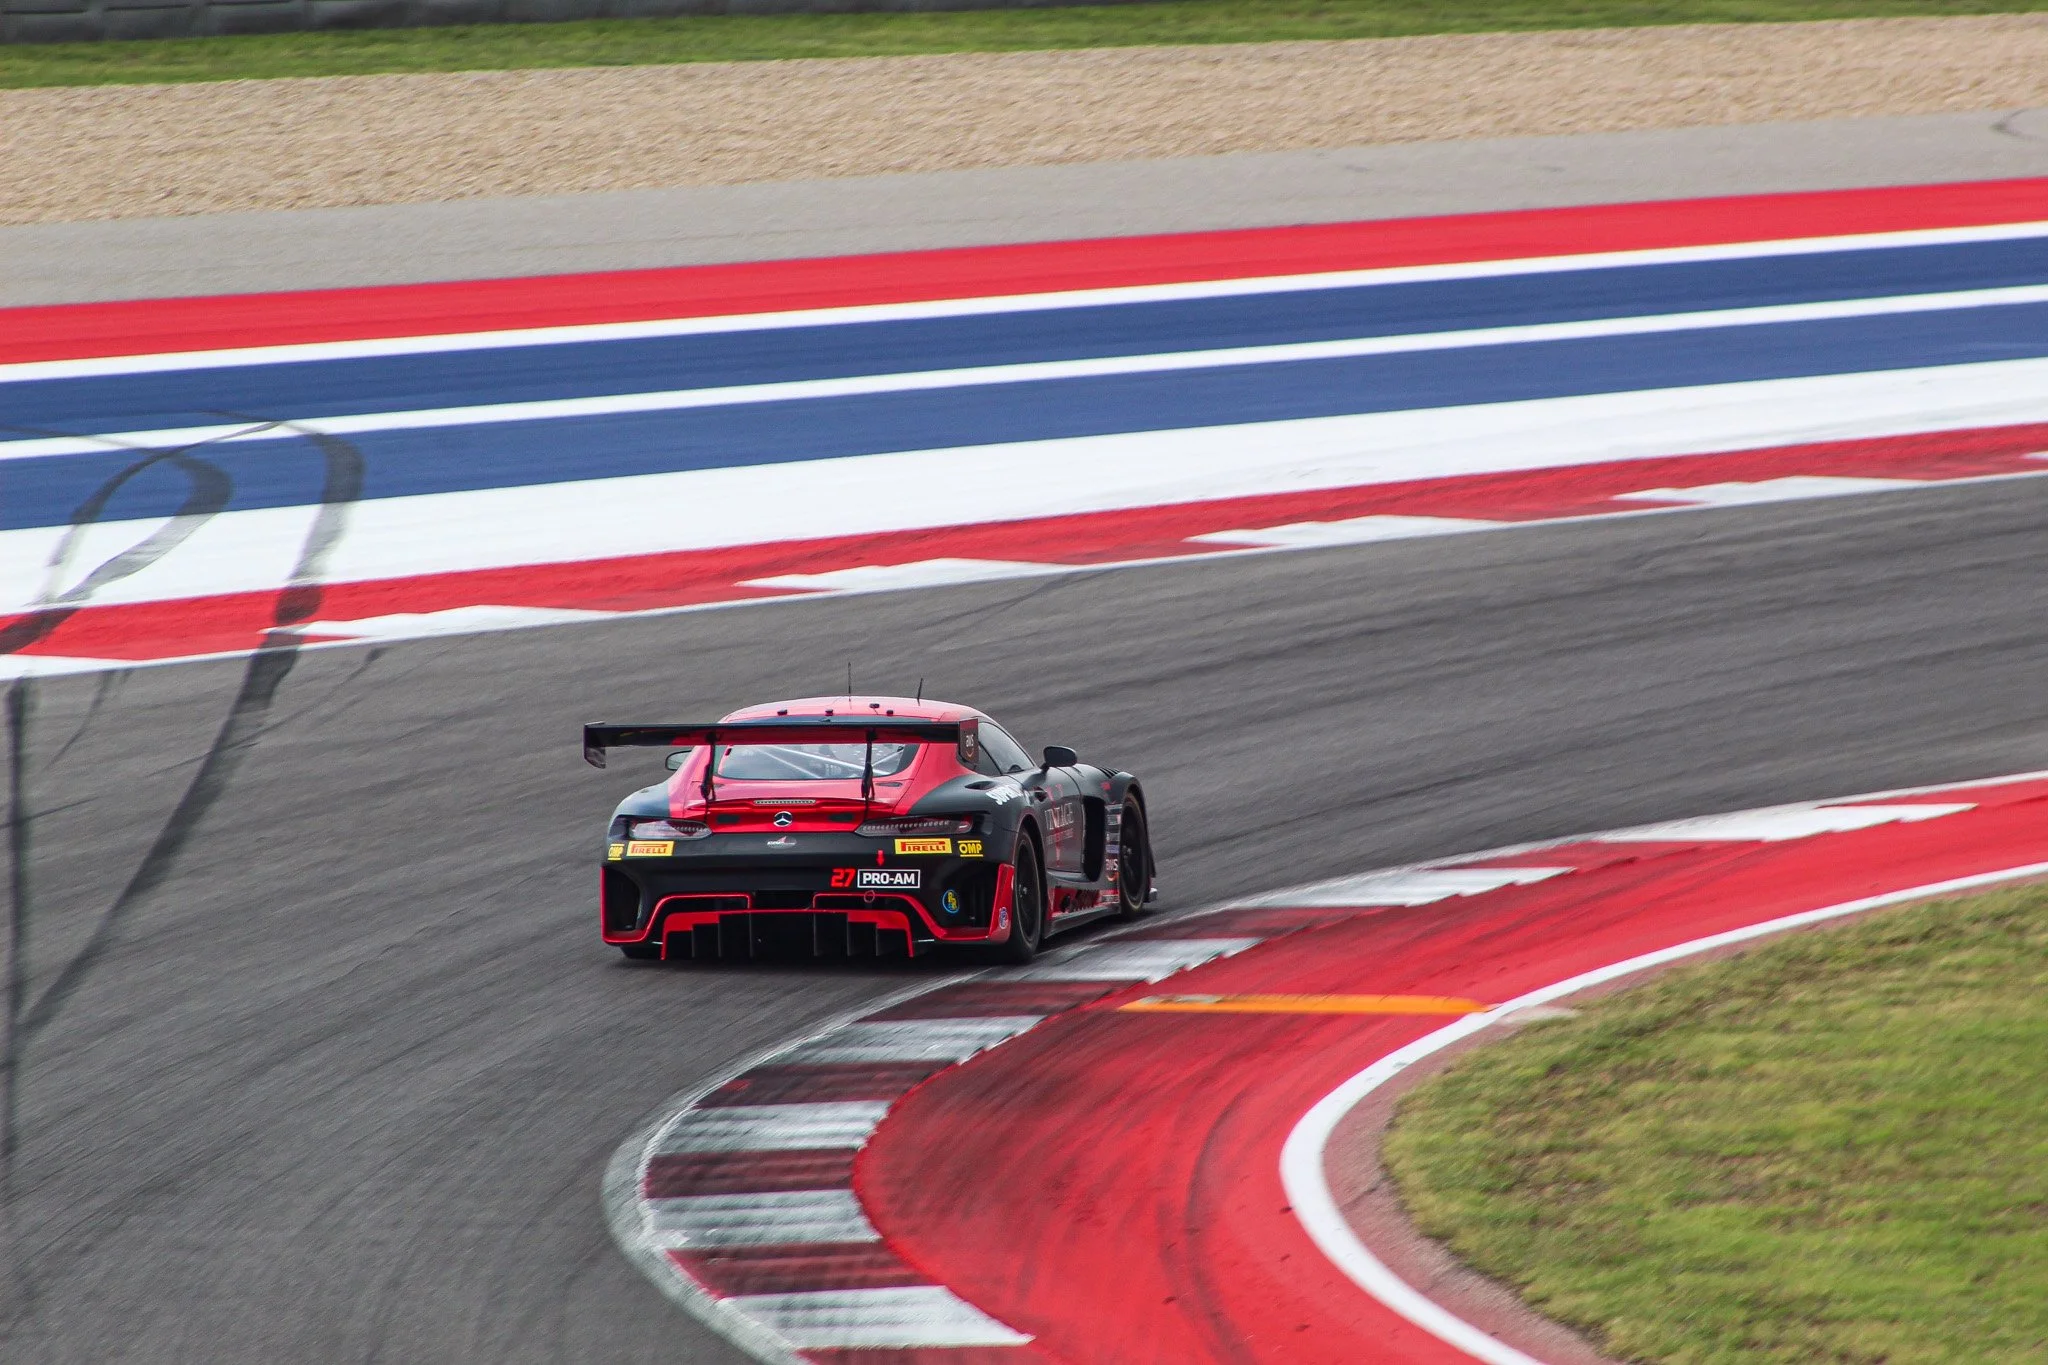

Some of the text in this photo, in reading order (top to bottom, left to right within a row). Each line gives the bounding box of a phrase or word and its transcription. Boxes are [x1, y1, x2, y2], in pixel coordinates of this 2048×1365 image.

[608, 845, 624, 858] OMP
[631, 843, 667, 854] PIRELLI
[901, 841, 946, 852] PIRELLI
[959, 842, 982, 854] OMP
[831, 869, 915, 887] 27 PRO-AM
